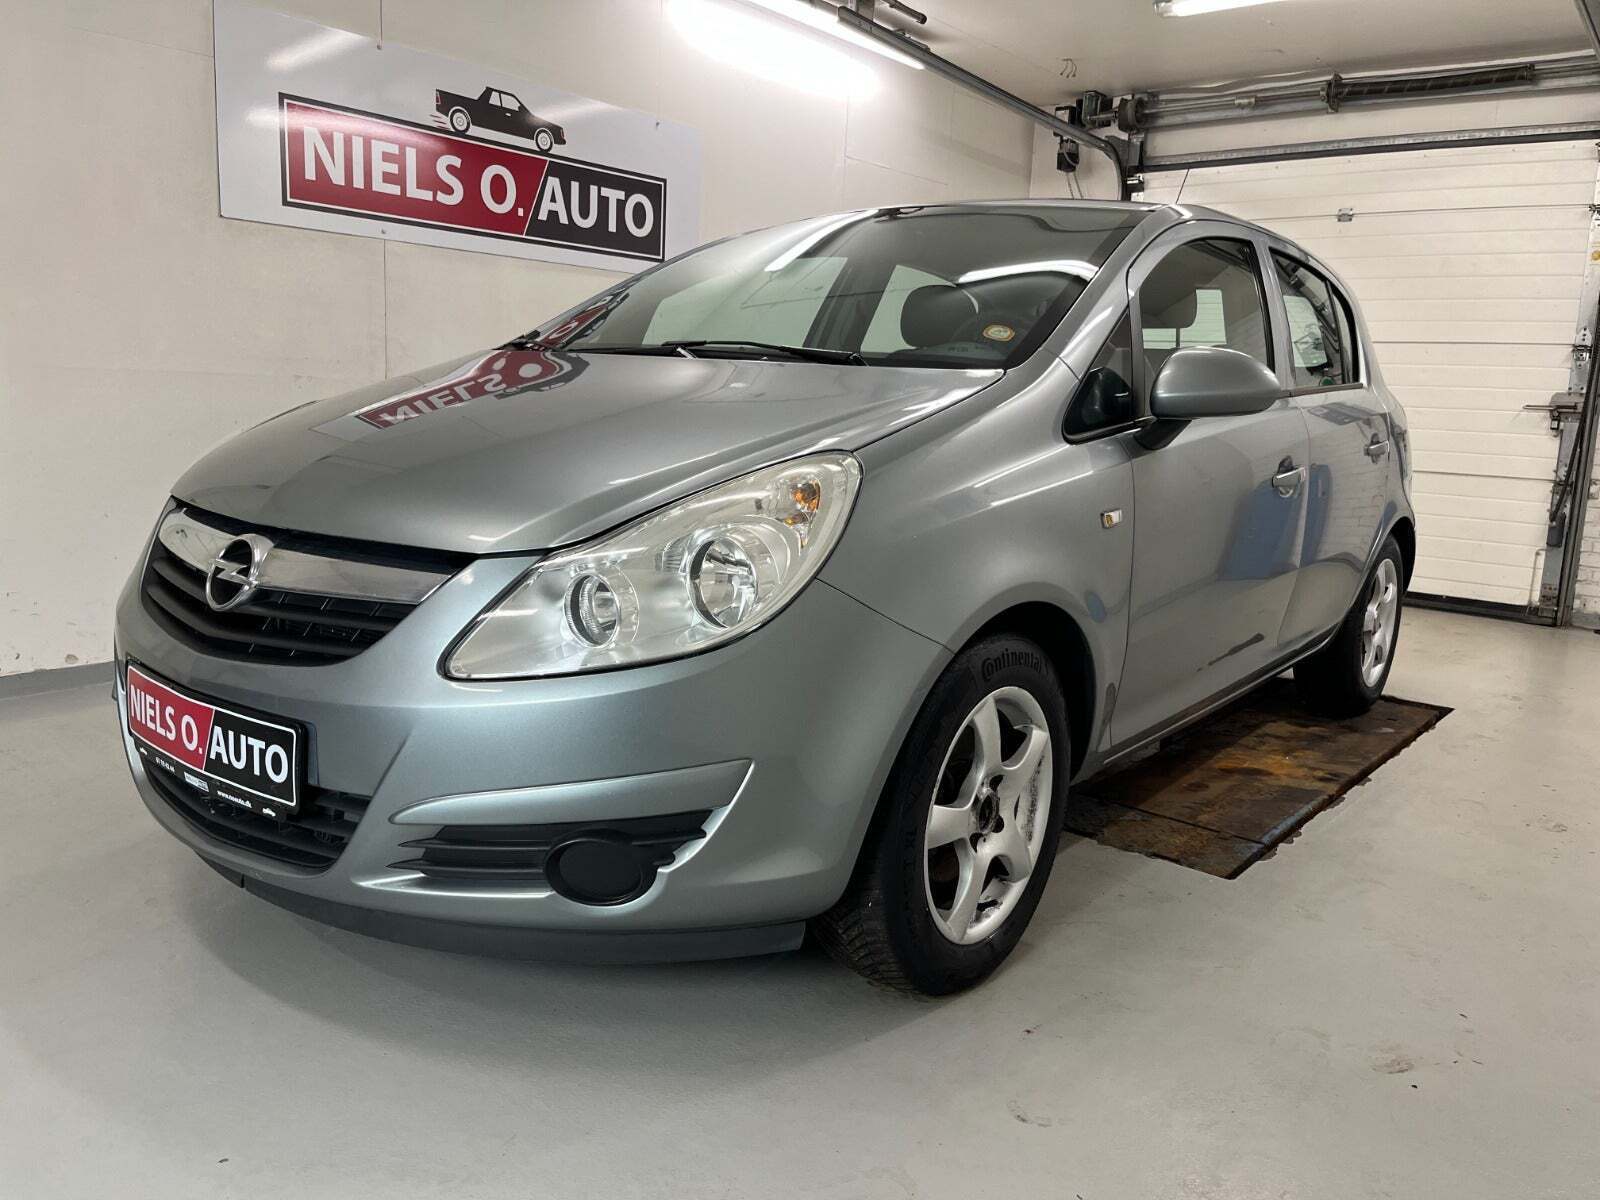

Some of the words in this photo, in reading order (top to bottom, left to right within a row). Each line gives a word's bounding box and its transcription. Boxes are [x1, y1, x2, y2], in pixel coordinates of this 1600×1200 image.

[304, 127, 462, 206] NIELS
[480, 165, 524, 217] O.
[538, 177, 654, 237] AUTO
[130, 685, 175, 740] NIELS
[181, 715, 203, 754] O.
[209, 726, 288, 783] AUTO
